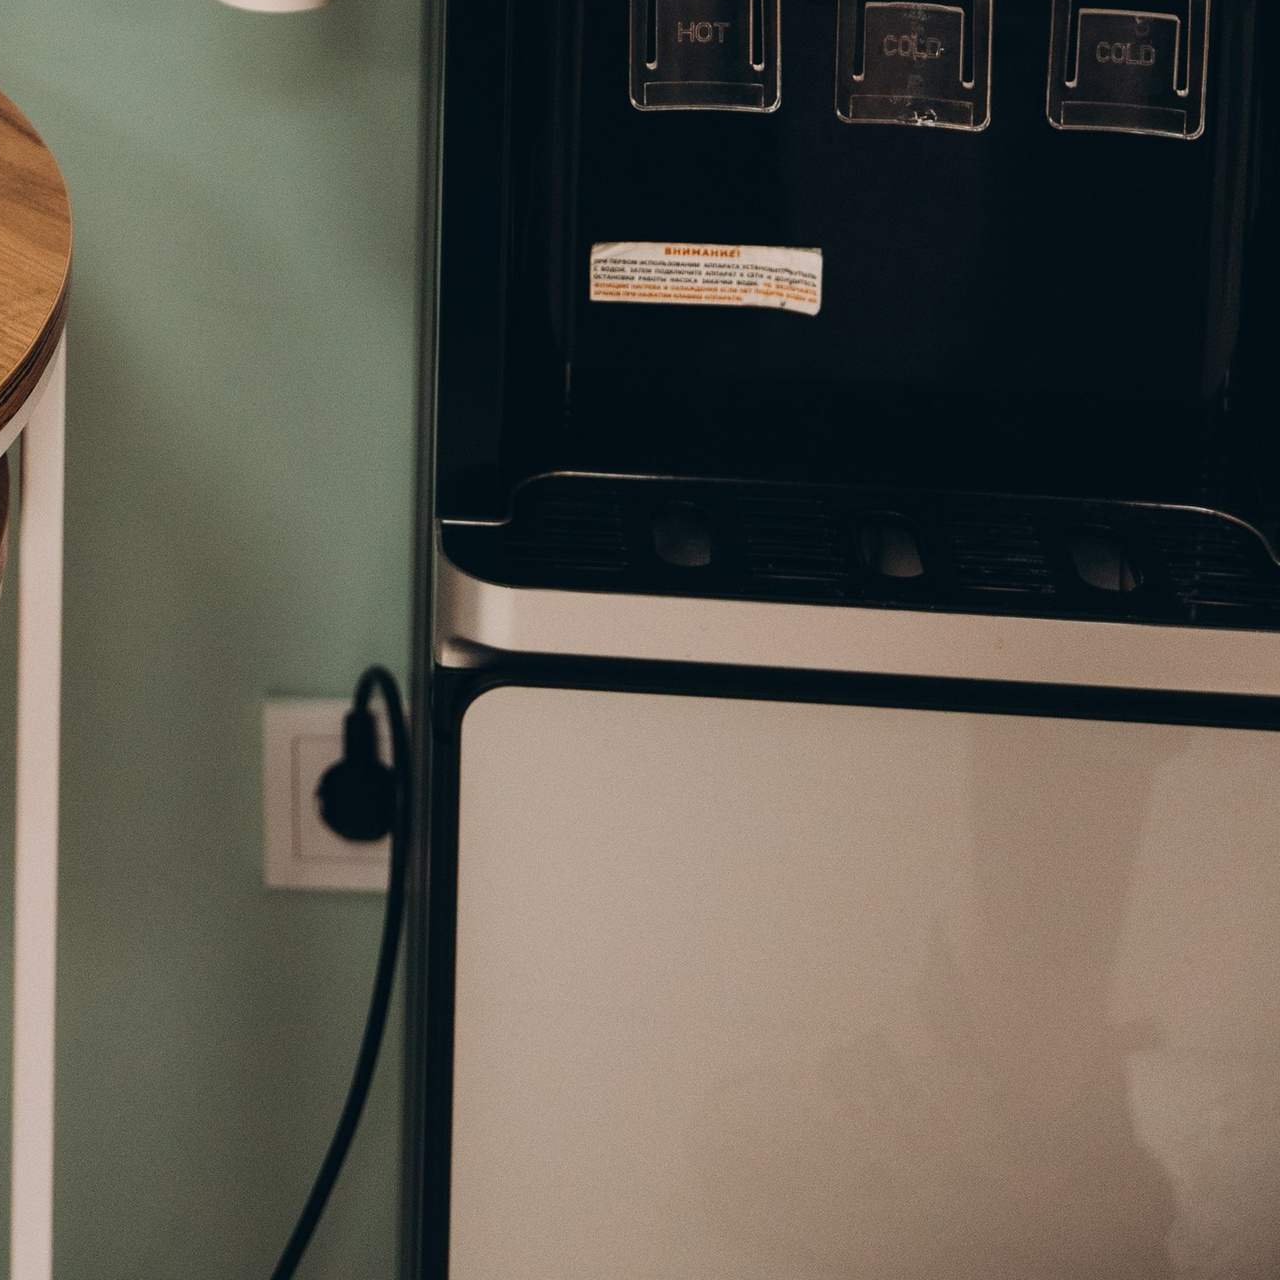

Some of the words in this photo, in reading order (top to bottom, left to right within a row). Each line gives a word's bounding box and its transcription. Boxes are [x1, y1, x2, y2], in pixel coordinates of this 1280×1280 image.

[677, 21, 730, 43] HOT
[882, 34, 942, 59] COLD
[1095, 41, 1157, 66] COLD
[664, 246, 741, 258] ВНИМАНИЕ!
